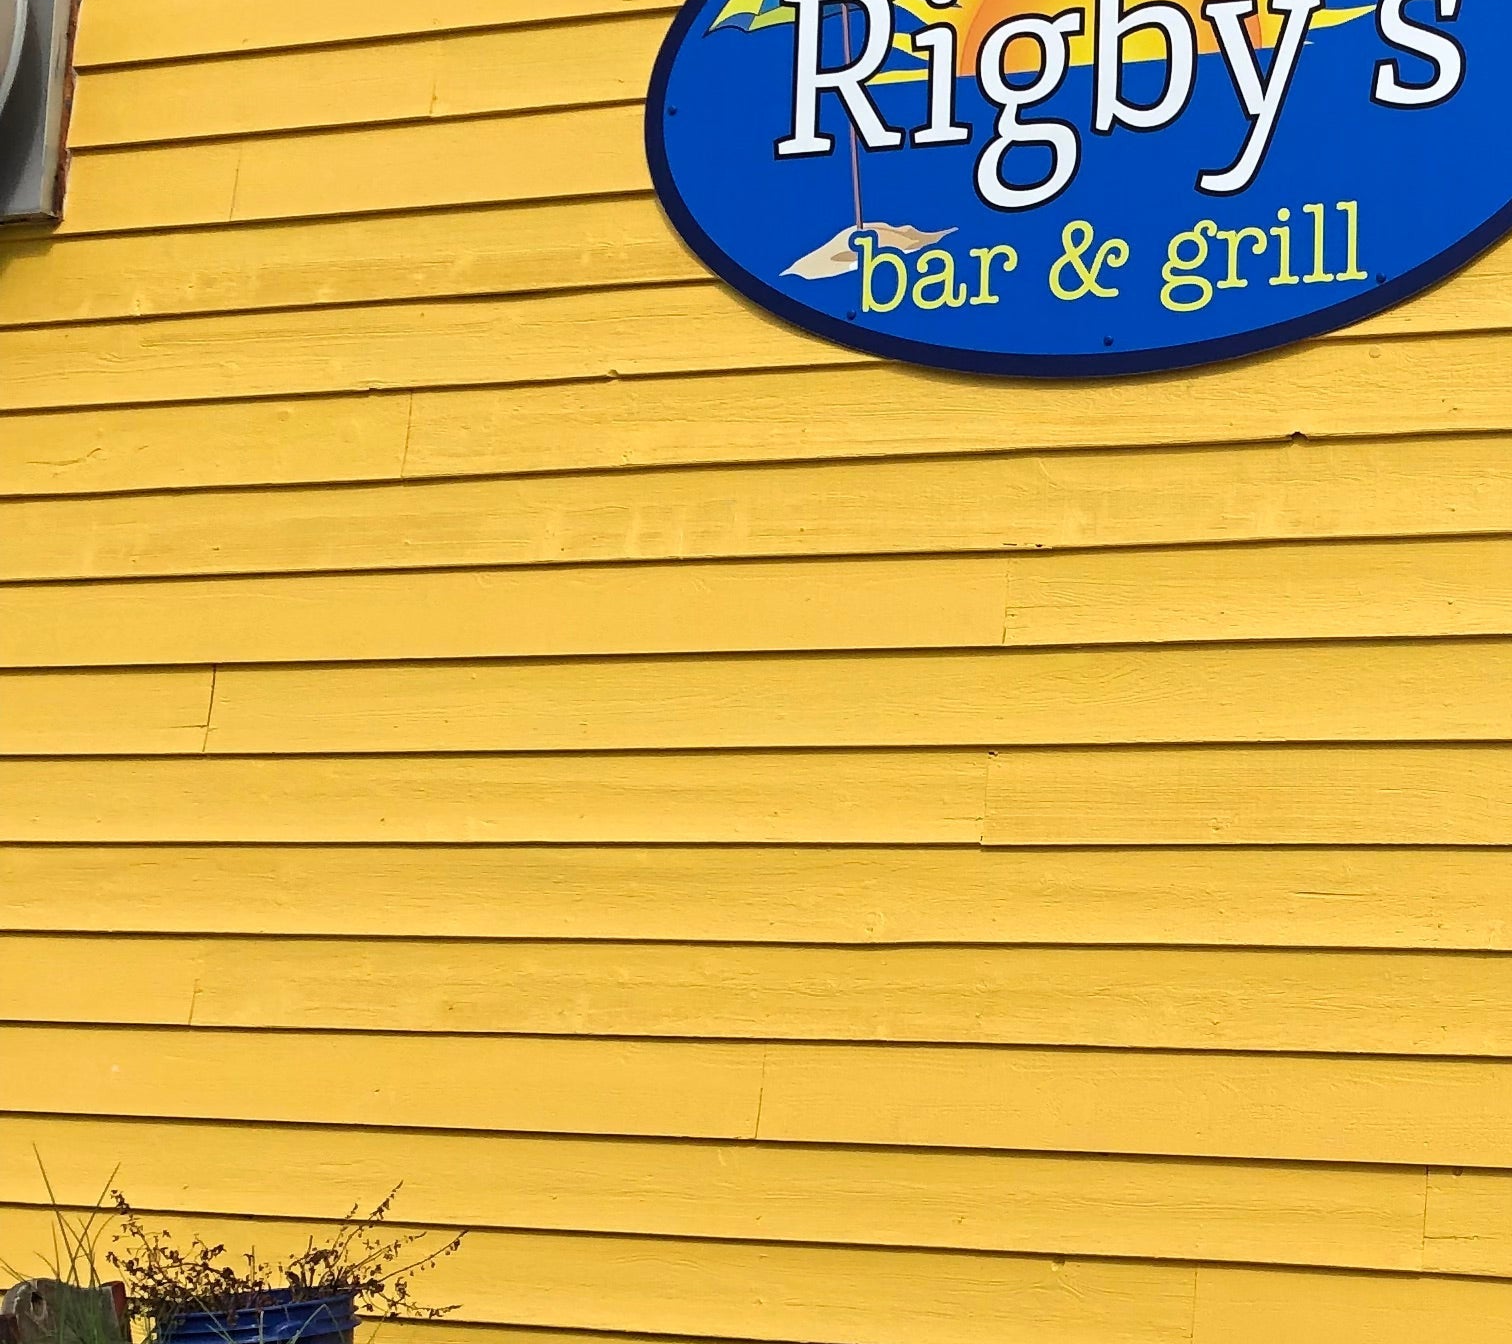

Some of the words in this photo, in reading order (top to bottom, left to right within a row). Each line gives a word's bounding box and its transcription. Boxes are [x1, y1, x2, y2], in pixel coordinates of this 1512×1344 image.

[853, 236, 1018, 313] bar
[1047, 219, 1131, 301] &
[1161, 200, 1368, 312] grill
